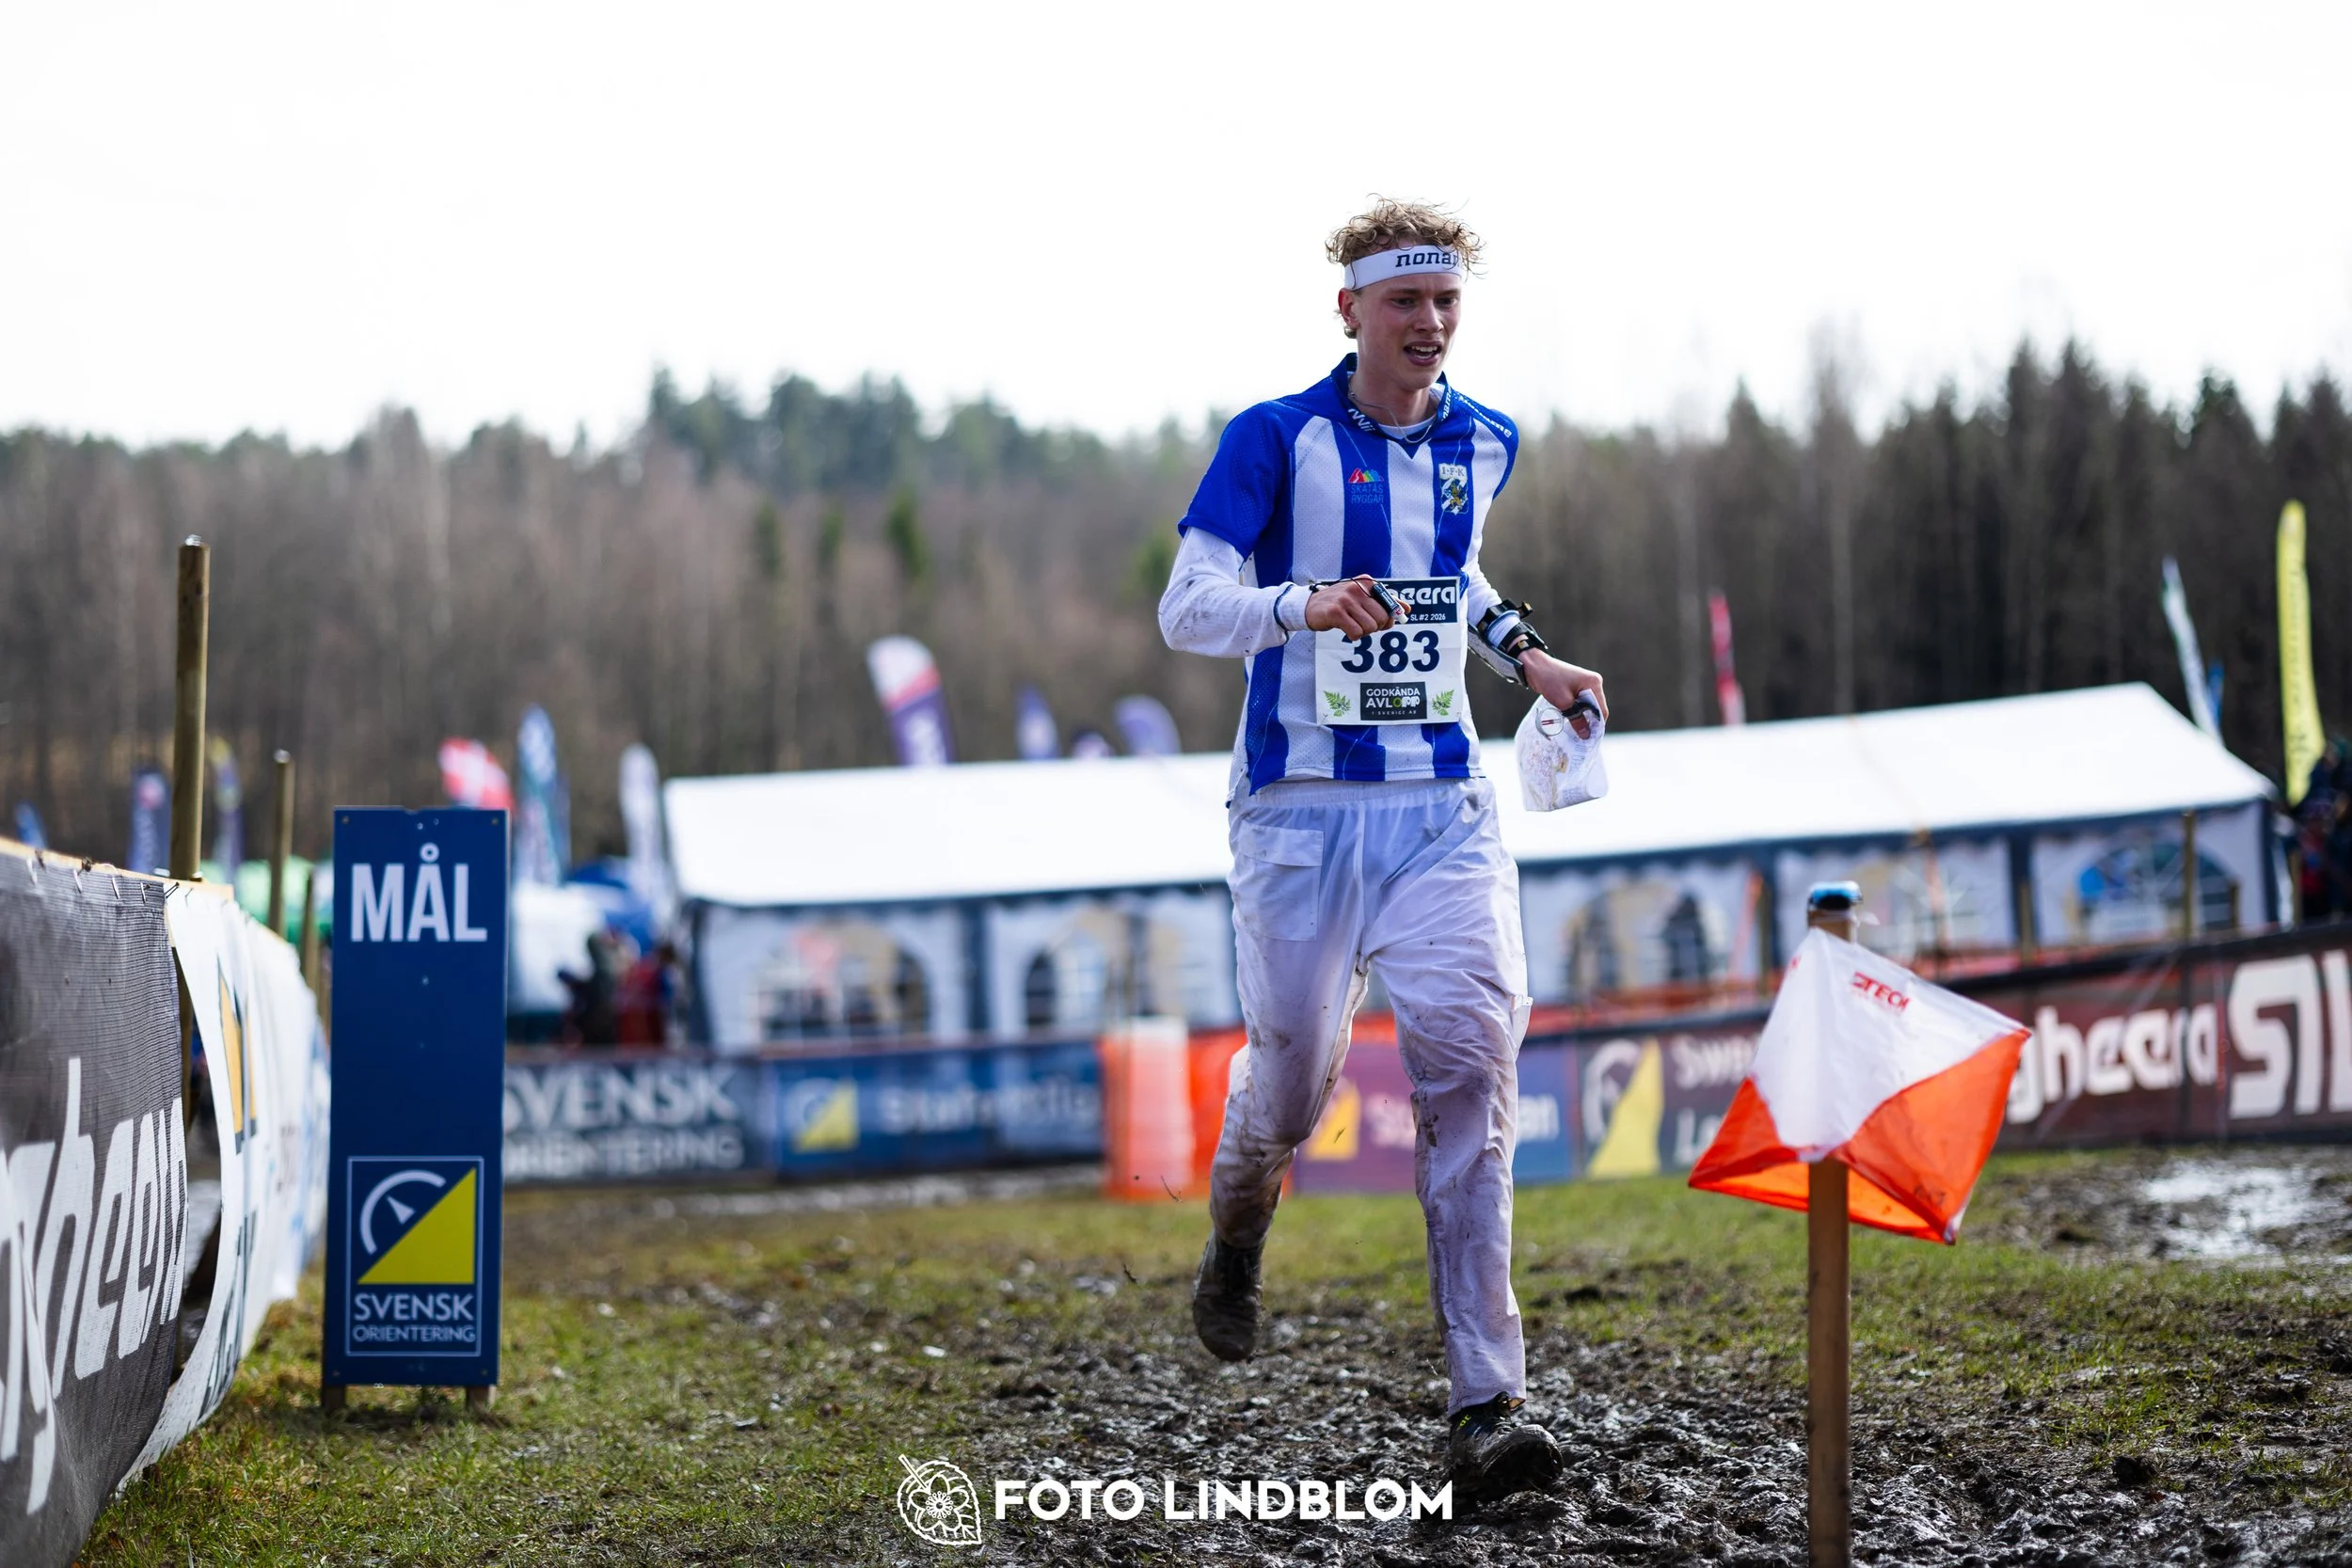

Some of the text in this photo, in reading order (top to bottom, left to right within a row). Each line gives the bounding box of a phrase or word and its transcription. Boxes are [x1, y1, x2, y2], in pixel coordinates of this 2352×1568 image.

[1341, 630, 1439, 673] 383
[1366, 687, 1421, 697] GODKÄNDA
[1366, 696, 1421, 708] AVLOPP
[351, 842, 488, 942] MÅL
[354, 1293, 474, 1321] SVENSK
[352, 1324, 476, 1343] ORIENTERING
